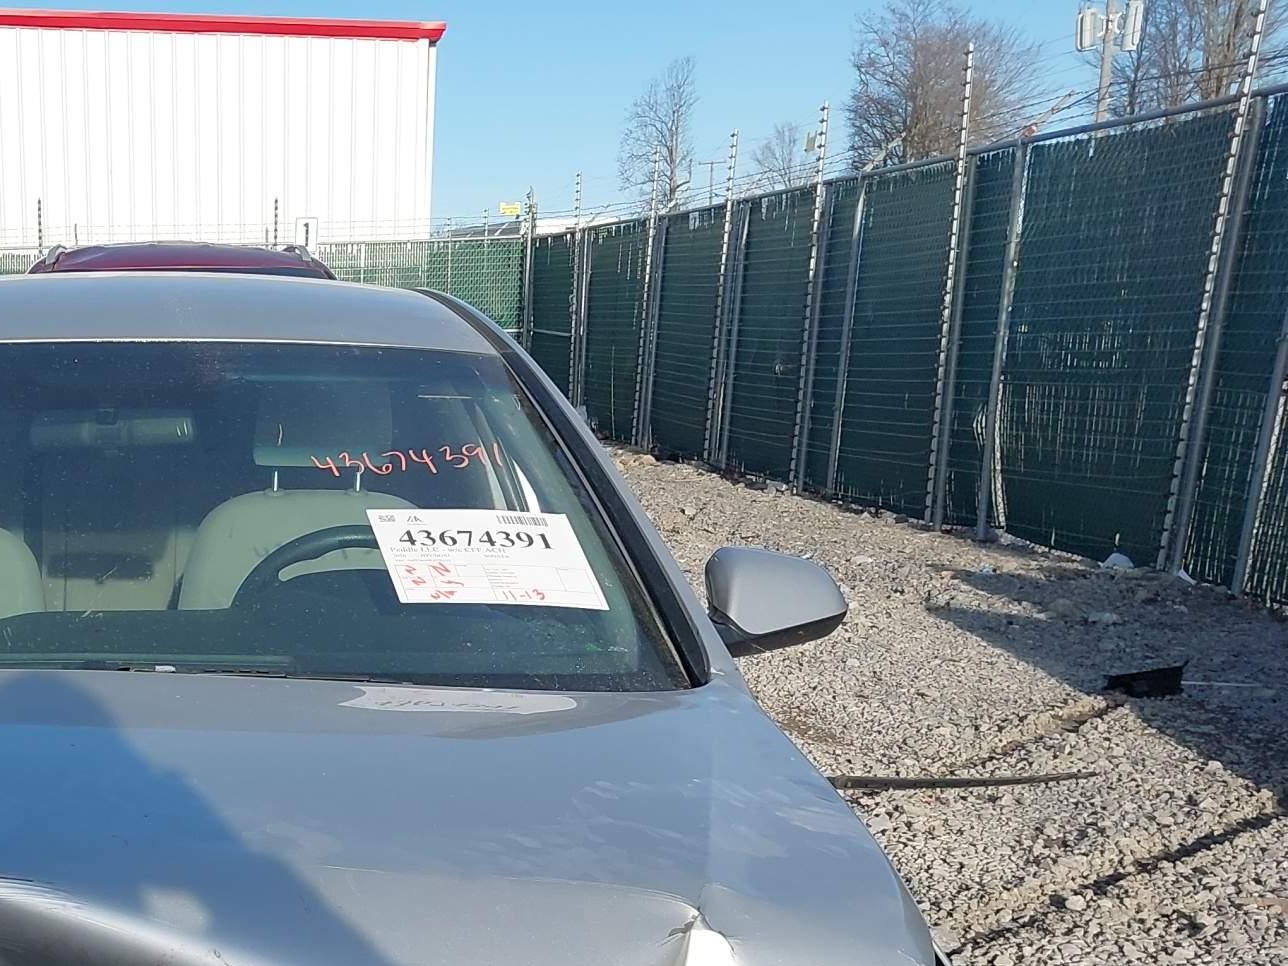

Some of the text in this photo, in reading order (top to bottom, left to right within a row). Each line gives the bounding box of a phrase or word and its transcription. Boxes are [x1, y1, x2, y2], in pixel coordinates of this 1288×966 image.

[303, 222, 310, 247] 1
[311, 443, 503, 477] 43674391
[399, 529, 553, 549] 43674391
[503, 588, 546, 601] 11-13
